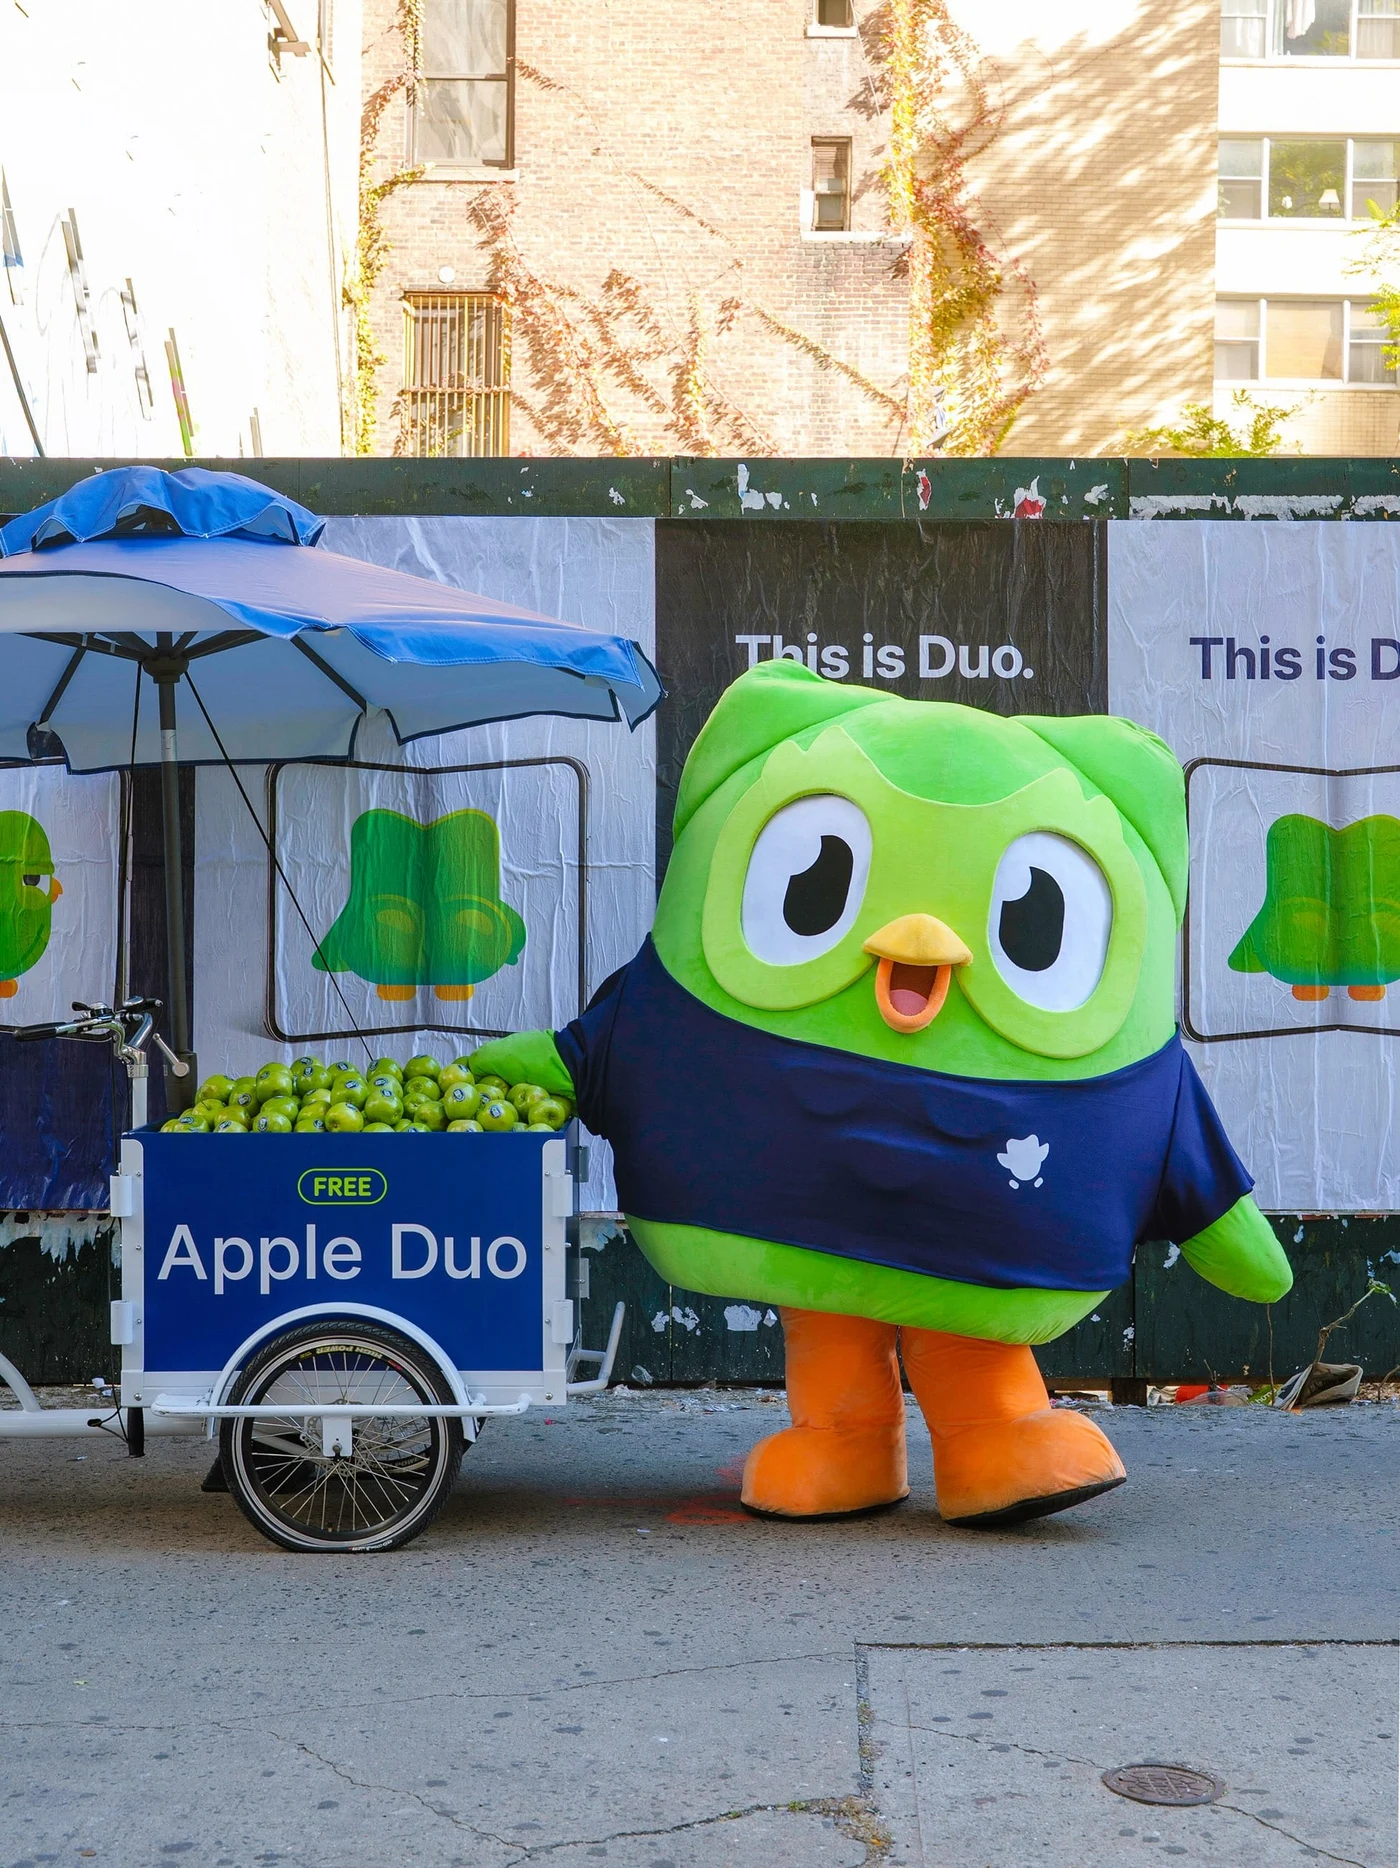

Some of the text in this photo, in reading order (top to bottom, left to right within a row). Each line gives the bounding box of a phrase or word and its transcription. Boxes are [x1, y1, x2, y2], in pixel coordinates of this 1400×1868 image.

[863, 632, 906, 679] is
[918, 634, 1035, 679] Duo.
[1189, 635, 1303, 681] This
[1316, 635, 1357, 681] is
[313, 1177, 372, 1197] FREE
[157, 1223, 528, 1295] Apple Duo
[316, 1344, 355, 1355] POWER
[354, 1347, 383, 1360] HIGH
